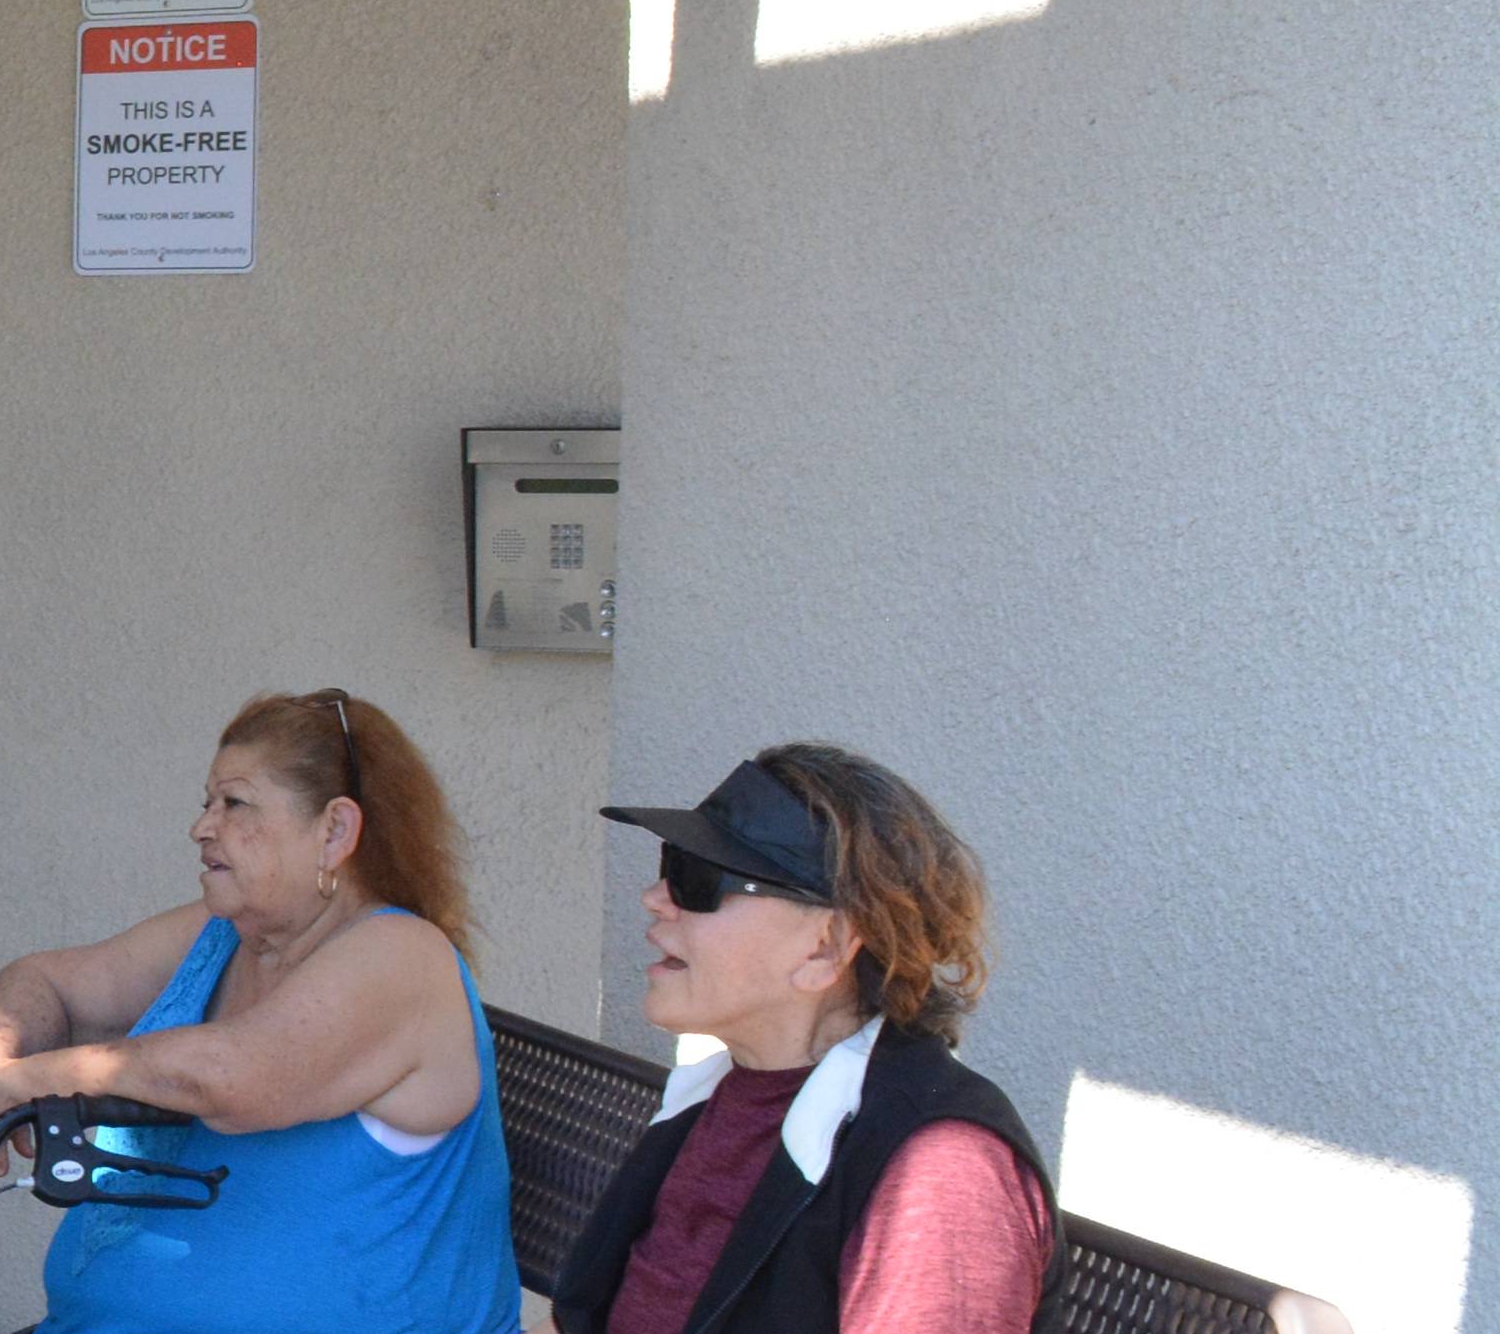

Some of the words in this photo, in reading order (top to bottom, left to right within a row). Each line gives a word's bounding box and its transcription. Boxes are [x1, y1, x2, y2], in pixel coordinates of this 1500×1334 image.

[110, 35, 227, 64] NOTICE
[120, 101, 168, 119] THIS
[176, 101, 195, 118] IS
[199, 100, 215, 117] A
[87, 131, 247, 154] SMOKE-FREE
[107, 165, 226, 185] PROPERTY
[97, 212, 127, 221] THANK
[129, 212, 148, 221] YOU
[171, 211, 190, 220] NOT
[192, 211, 235, 220] SMOKING
